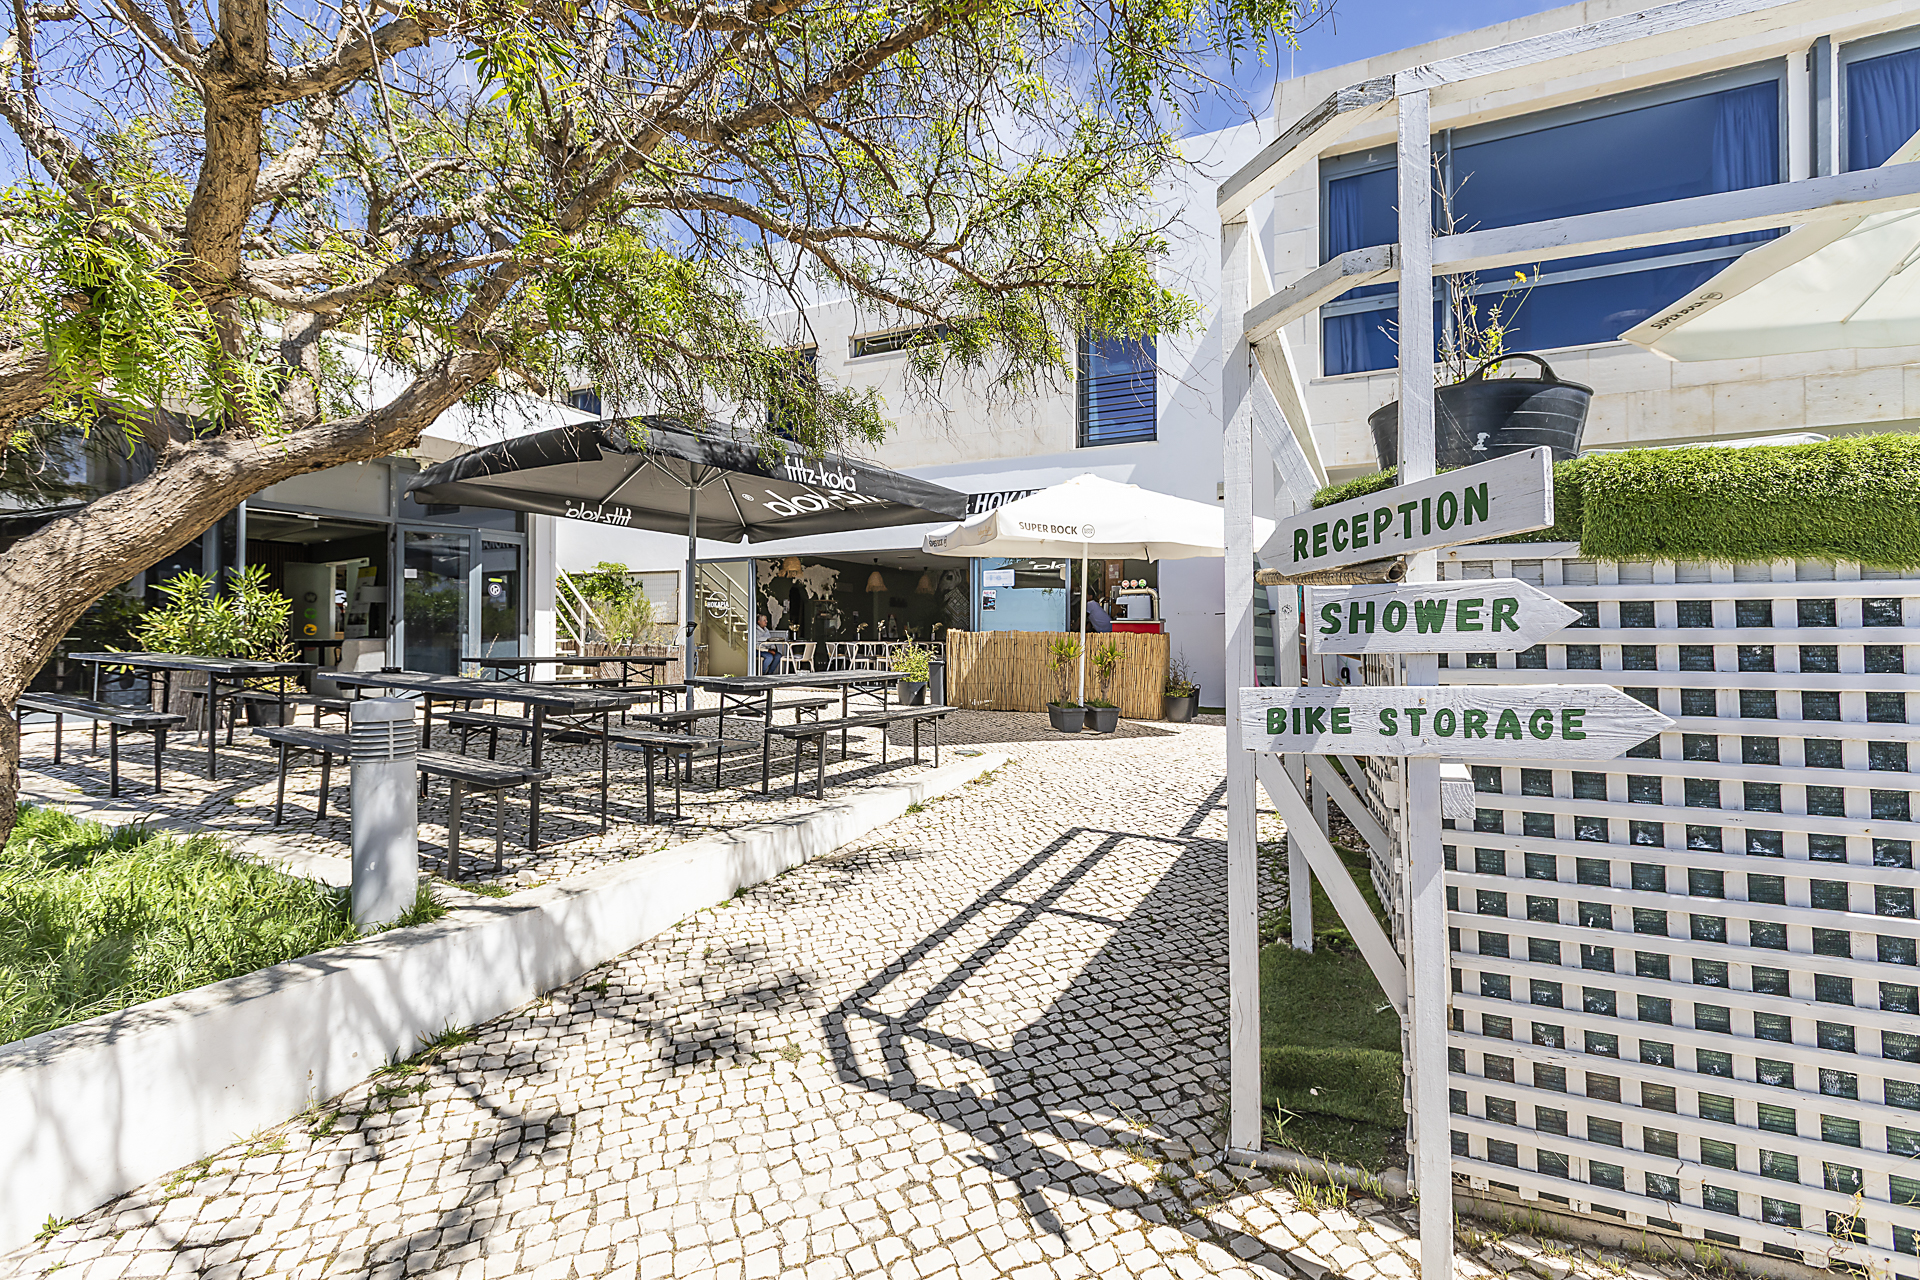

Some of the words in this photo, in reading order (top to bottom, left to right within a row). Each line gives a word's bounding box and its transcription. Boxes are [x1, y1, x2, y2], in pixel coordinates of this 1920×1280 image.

[1019, 521, 1049, 533] SUPER
[1050, 524, 1078, 535] BOCK
[1293, 482, 1489, 562] RECEPTION
[1318, 597, 1520, 635] SHOWER
[1266, 705, 1352, 736] BIKE
[1378, 707, 1588, 741] STORAGE
